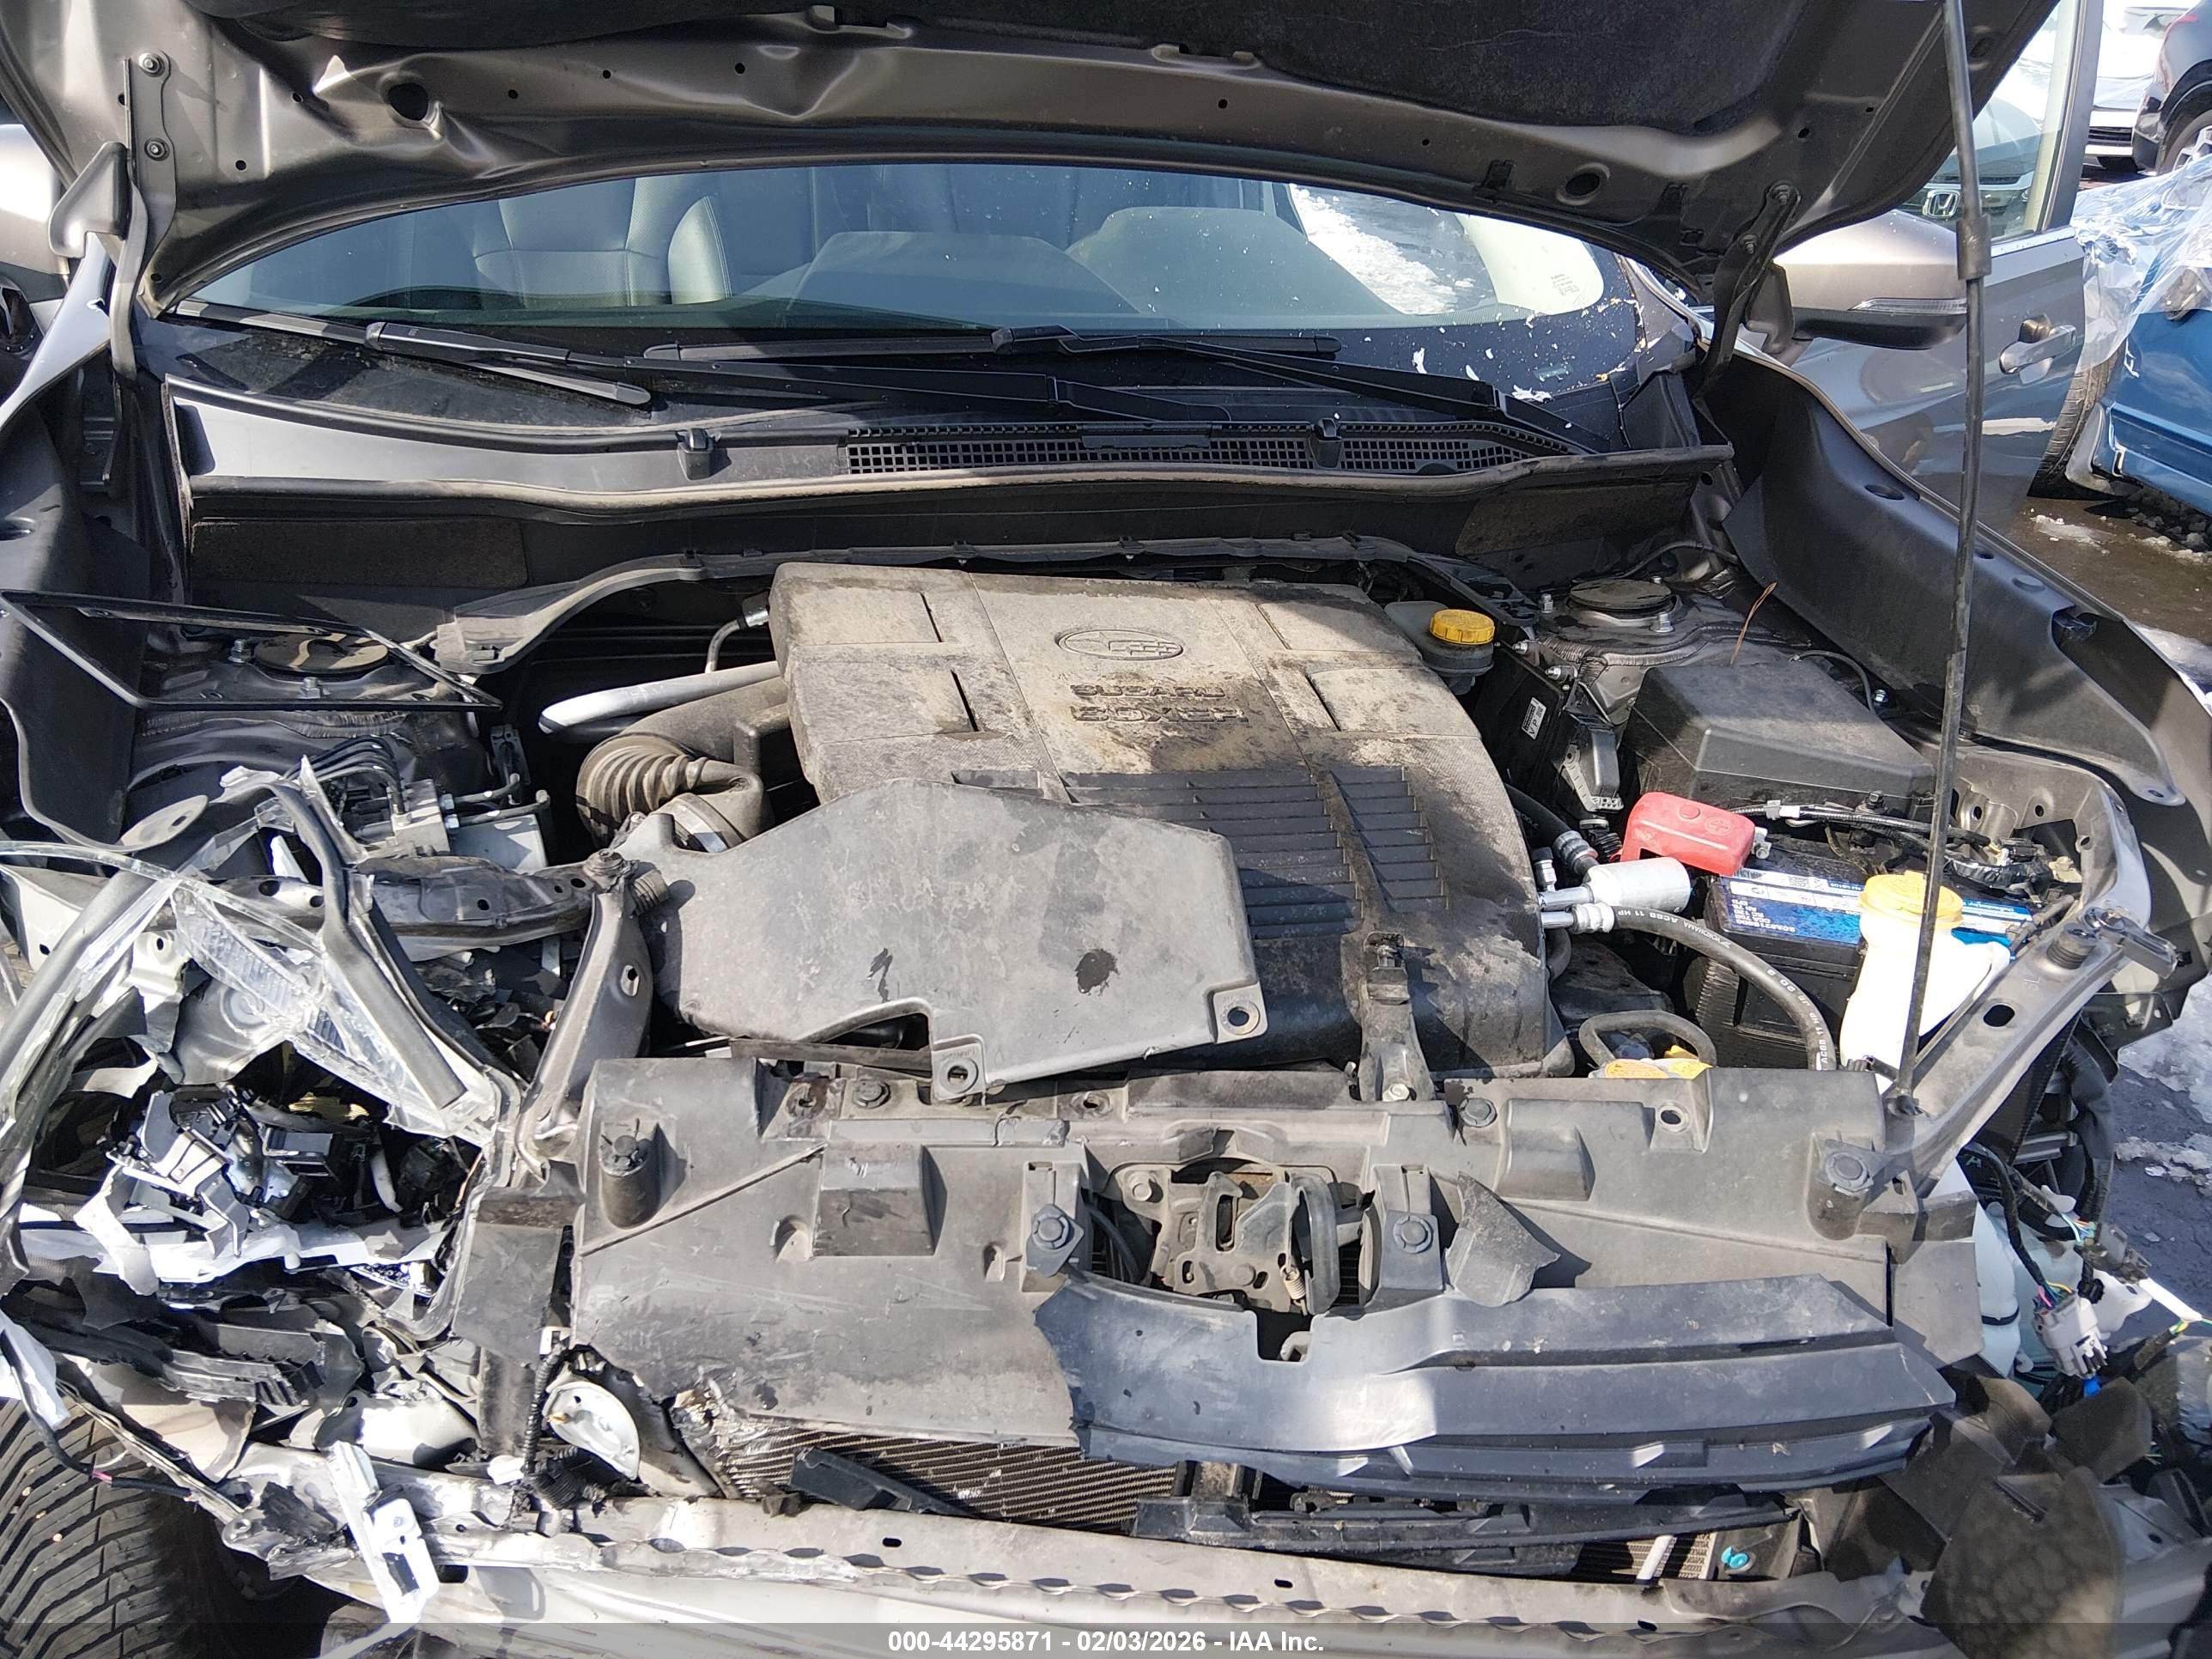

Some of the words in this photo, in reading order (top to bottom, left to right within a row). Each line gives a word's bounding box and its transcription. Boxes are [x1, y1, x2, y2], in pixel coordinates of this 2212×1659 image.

[1070, 685, 1225, 697] SUBARU
[1070, 706, 1249, 722] BOXER
[1683, 920, 1722, 944] YOKOHAMA
